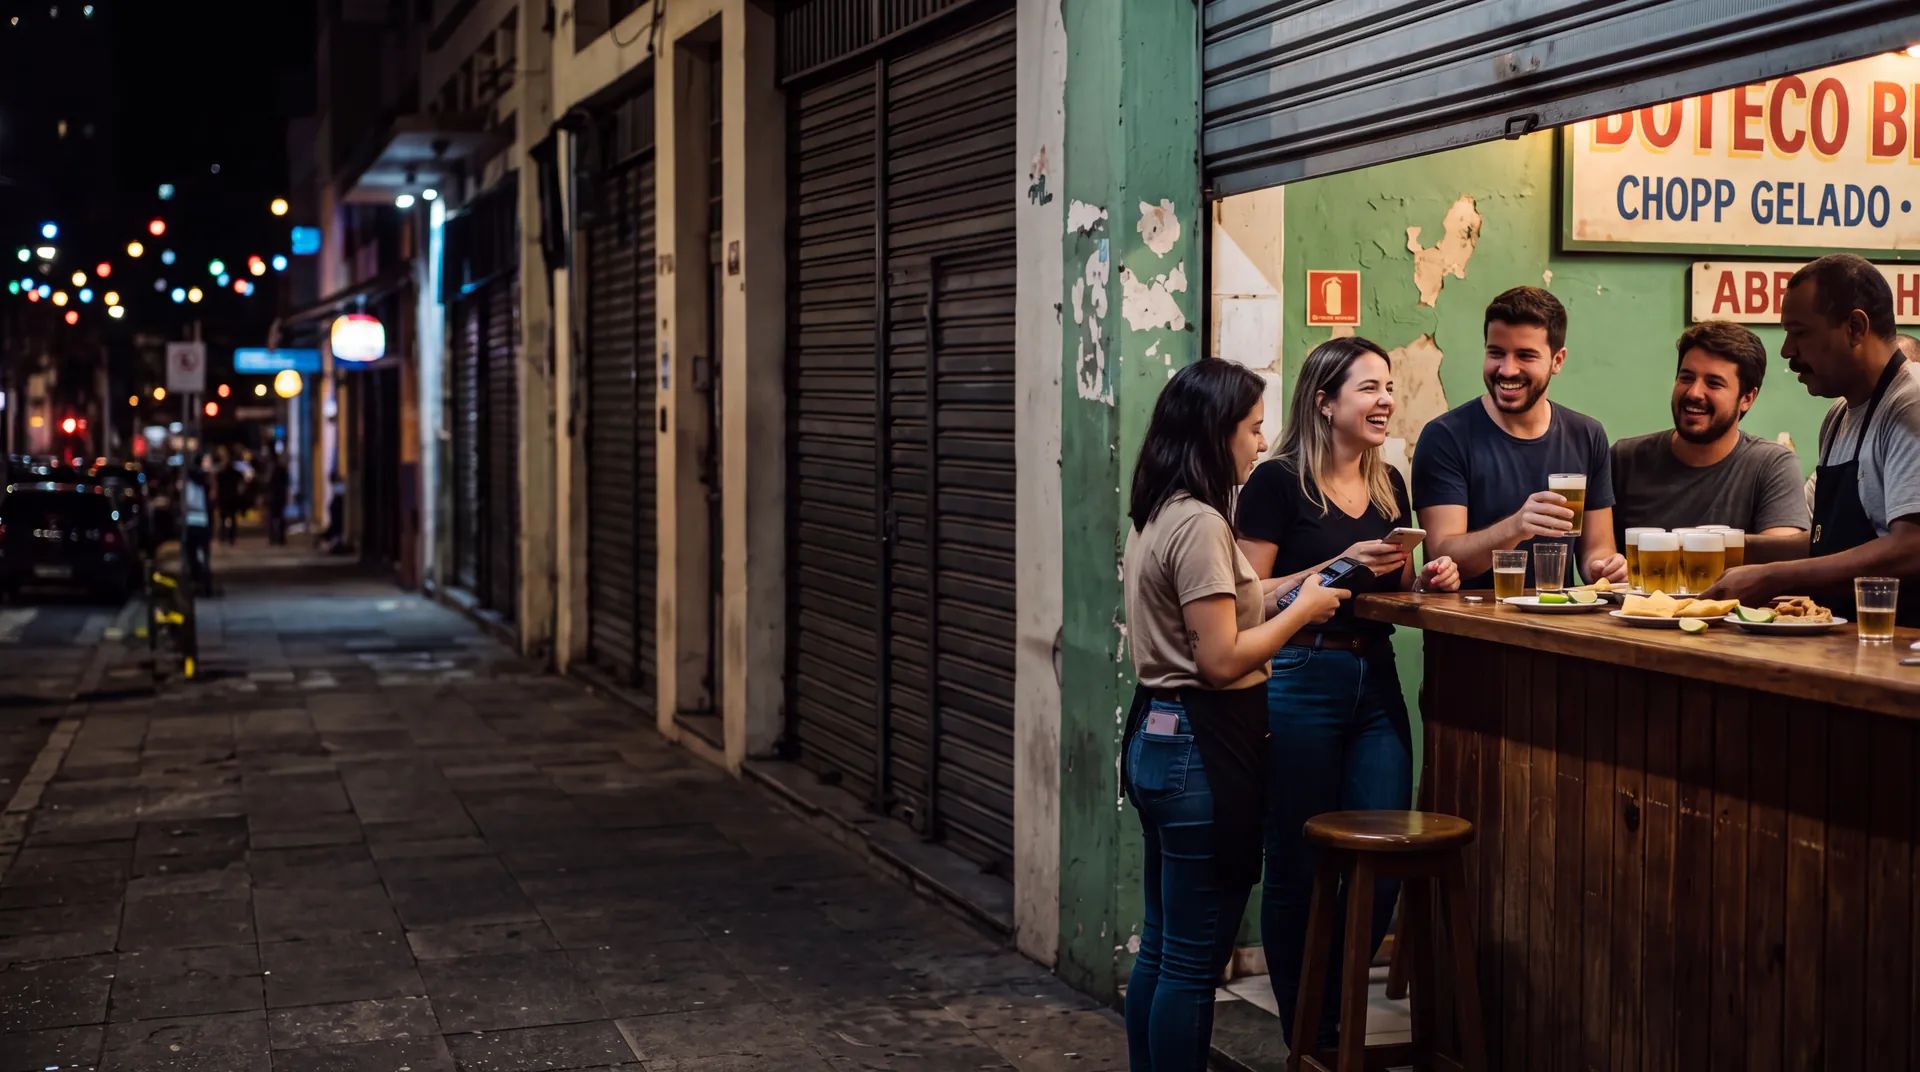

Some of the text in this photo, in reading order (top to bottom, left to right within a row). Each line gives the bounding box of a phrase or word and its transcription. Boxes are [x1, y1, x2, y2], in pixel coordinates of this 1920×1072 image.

[1868, 81, 1920, 162] B
[1617, 175, 1890, 228] CHOPP GELADO
